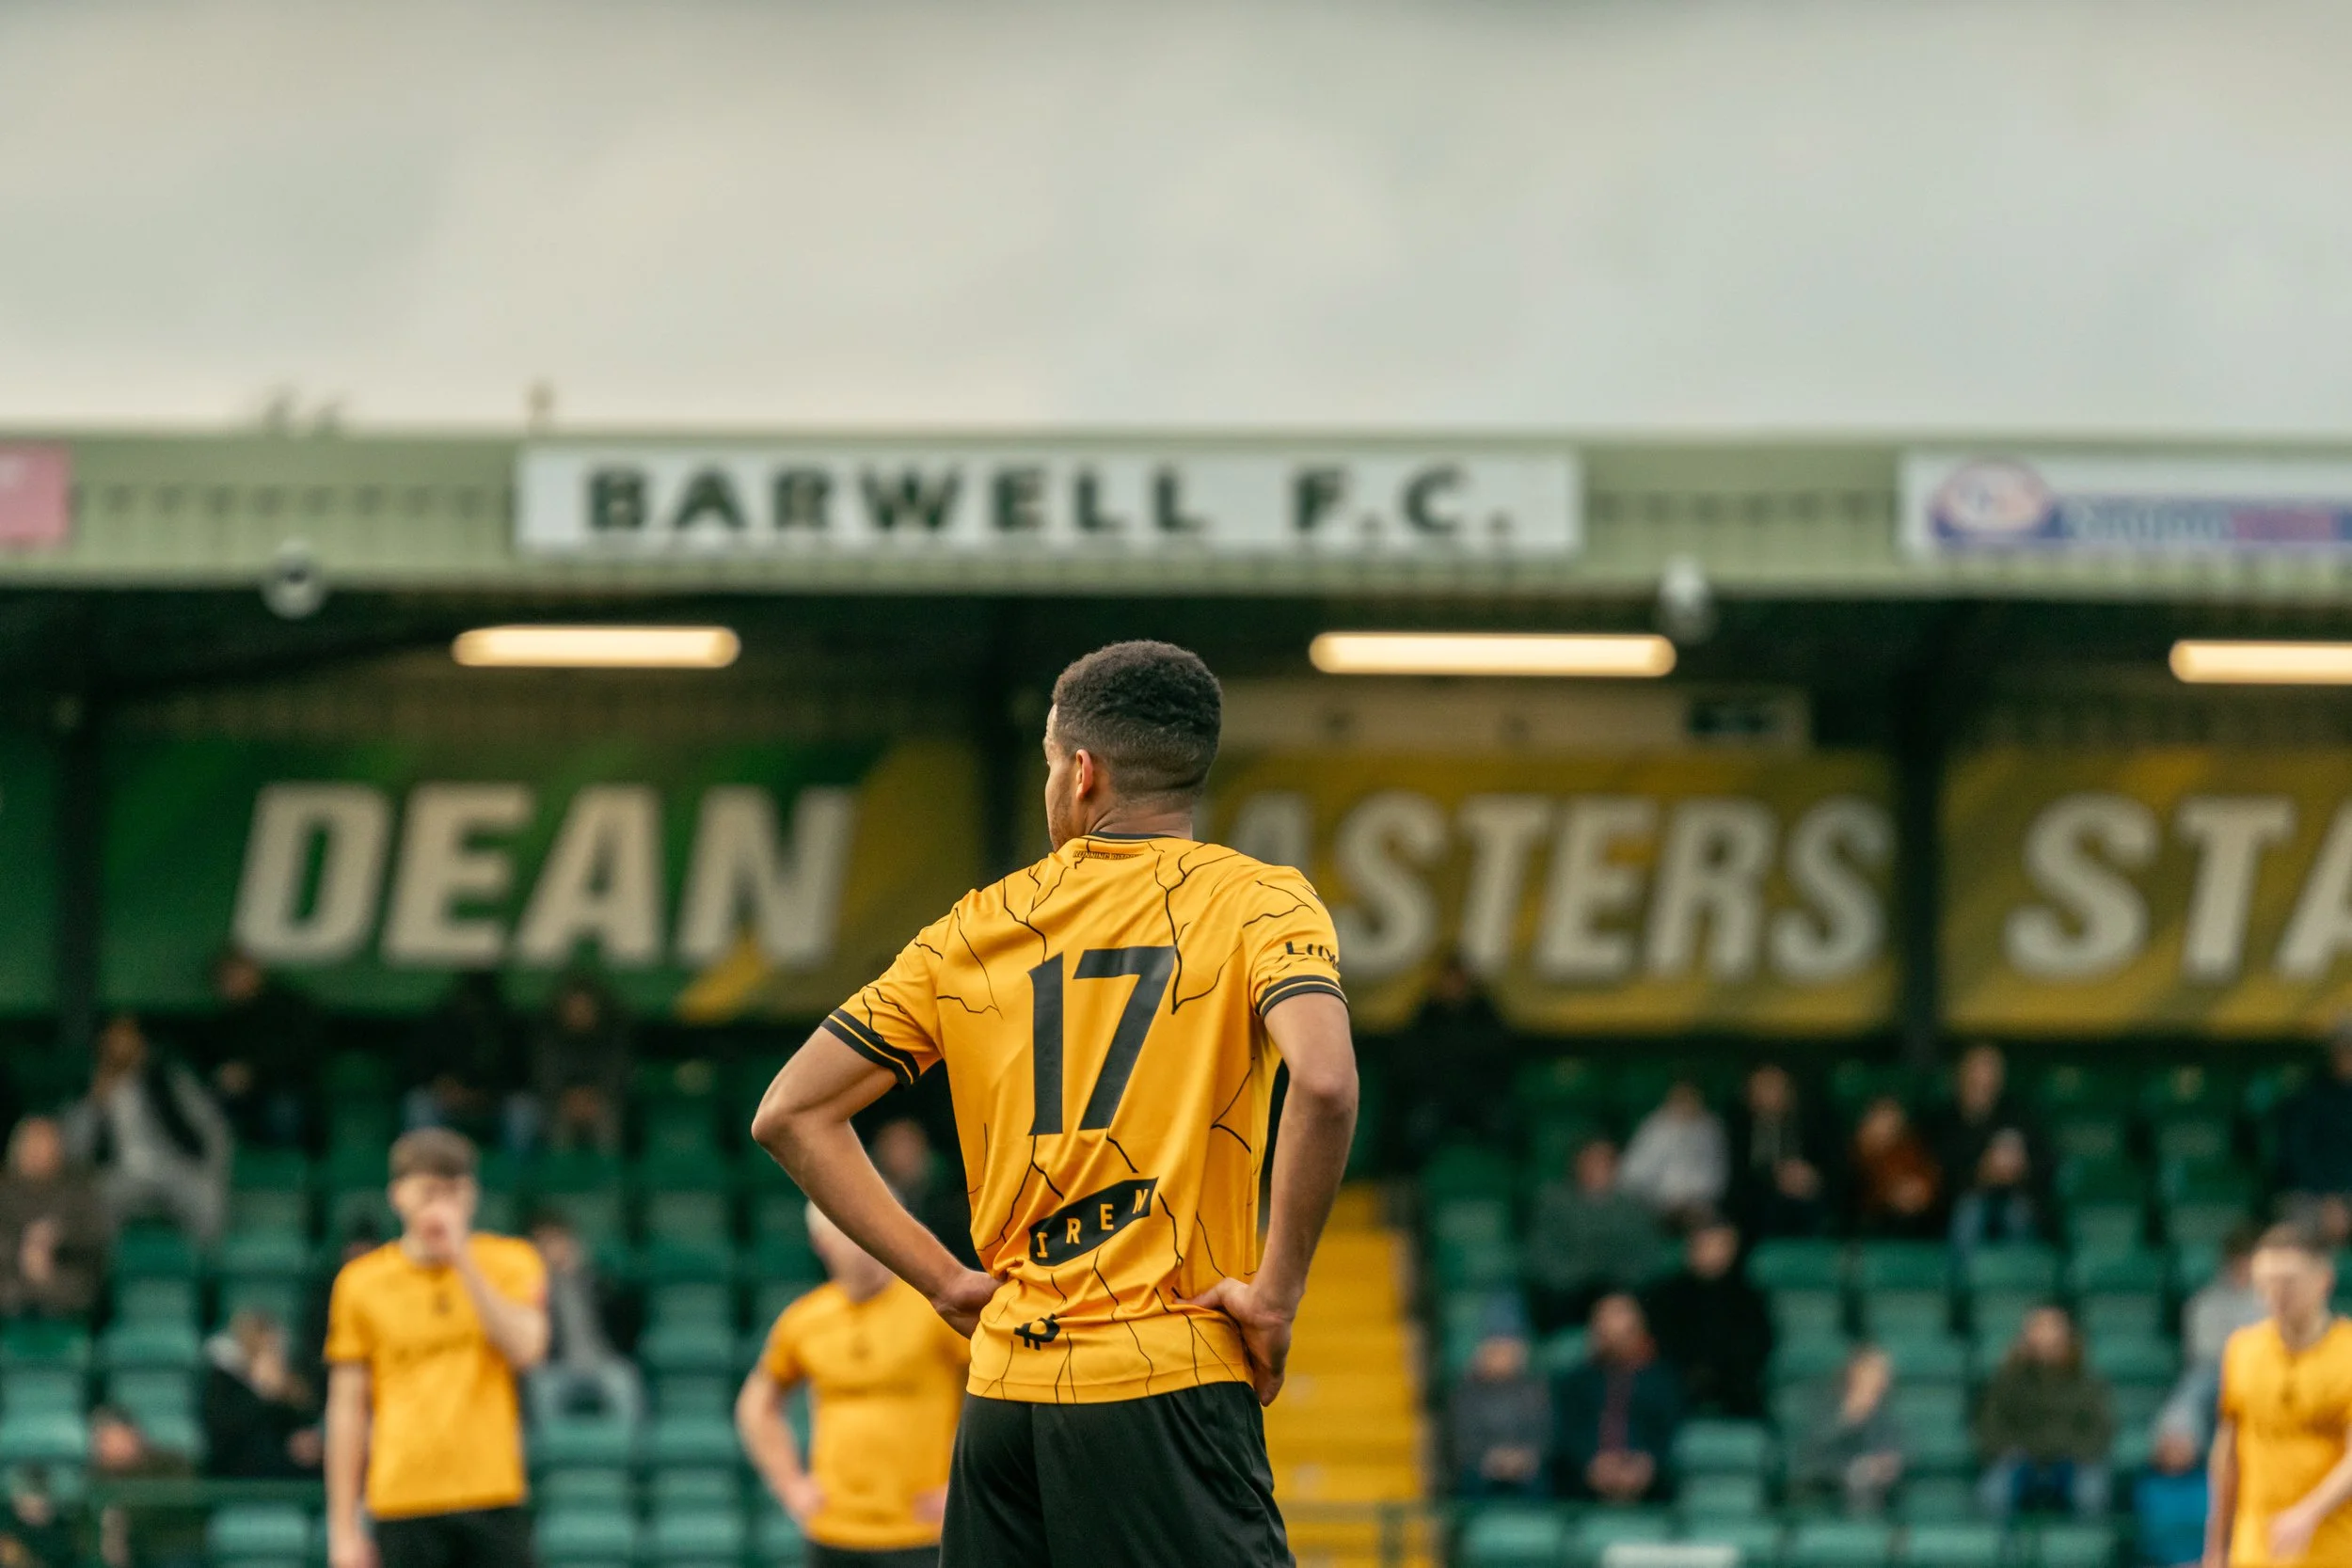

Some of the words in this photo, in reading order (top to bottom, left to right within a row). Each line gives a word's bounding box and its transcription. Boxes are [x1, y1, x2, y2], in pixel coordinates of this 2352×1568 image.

[587, 466, 1211, 536] BARWELL
[1289, 465, 1513, 538] F.C.
[231, 783, 852, 967] DEAN
[1192, 790, 1891, 982] STERS
[1027, 945, 1176, 1135] 17
[1036, 1188, 1149, 1259] IREN
